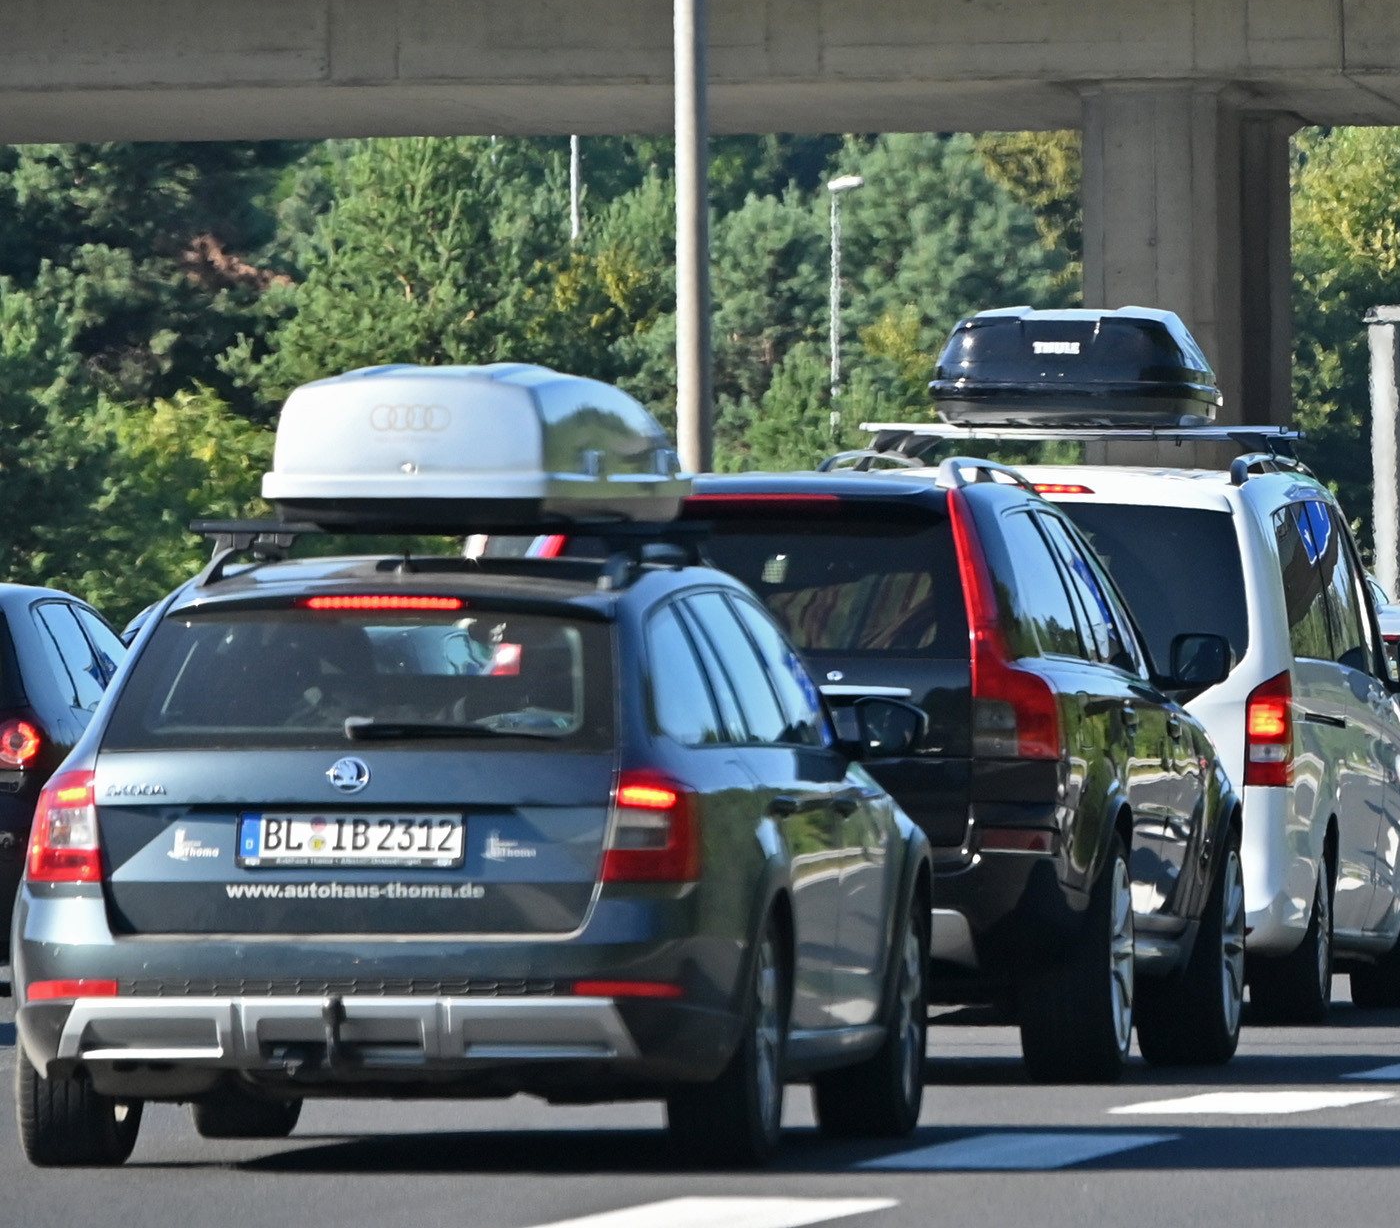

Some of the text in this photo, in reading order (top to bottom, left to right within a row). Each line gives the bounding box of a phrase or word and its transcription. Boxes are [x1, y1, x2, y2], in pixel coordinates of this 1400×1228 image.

[1032, 340, 1081, 355] THULE
[263, 818, 455, 852] BL IB 2312
[184, 847, 220, 858] Thoma
[225, 882, 485, 900] www.autohaus-thoma.de
